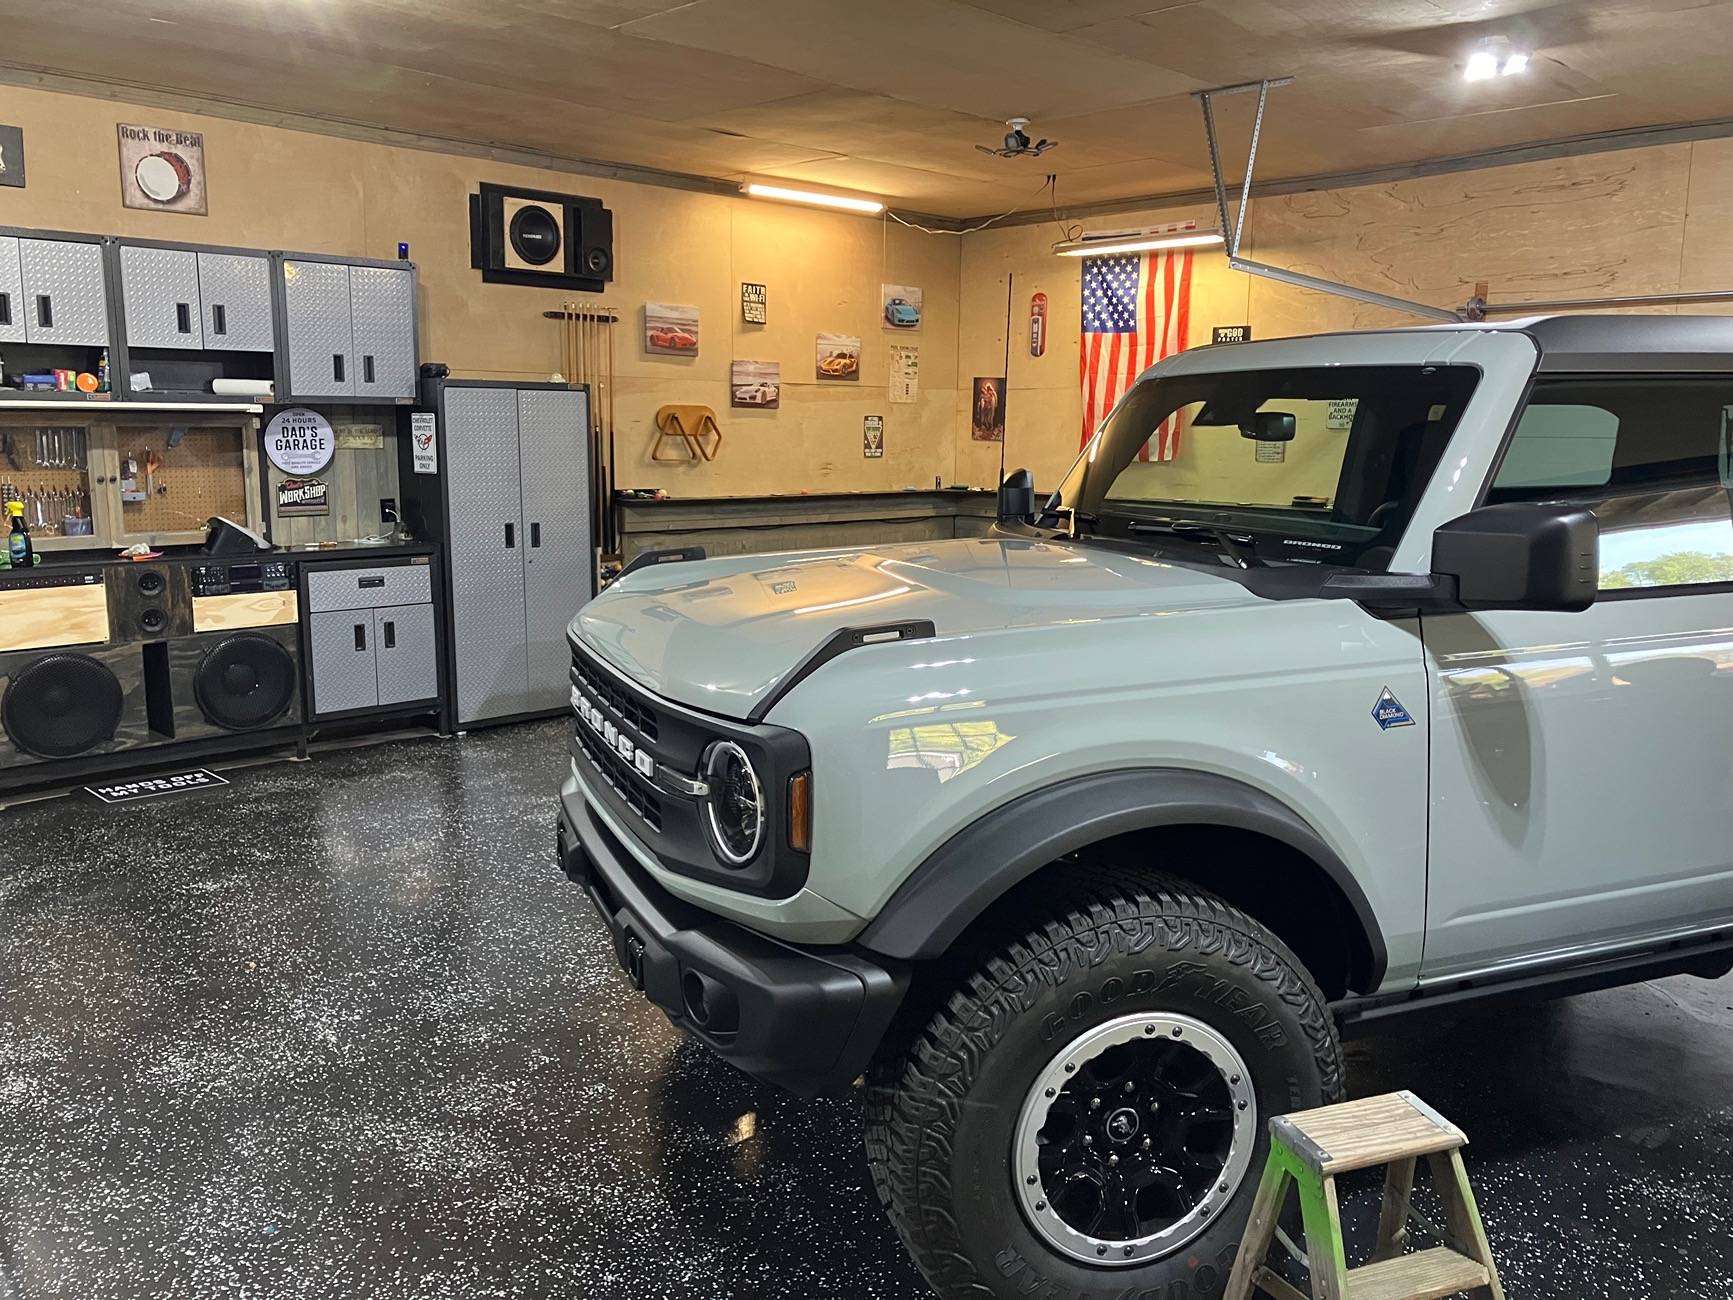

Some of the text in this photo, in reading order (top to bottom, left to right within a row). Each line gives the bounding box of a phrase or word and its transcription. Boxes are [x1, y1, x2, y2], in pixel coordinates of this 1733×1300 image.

[121, 126, 202, 147] Rock the Beat
[281, 426, 318, 438] DAD'S
[275, 438, 325, 451] GARAGE
[1283, 540, 1341, 550] BRONCO
[570, 684, 653, 777] BRONCO
[98, 773, 204, 793] HANDS OFF
[110, 778, 209, 797] MY TOOLS
